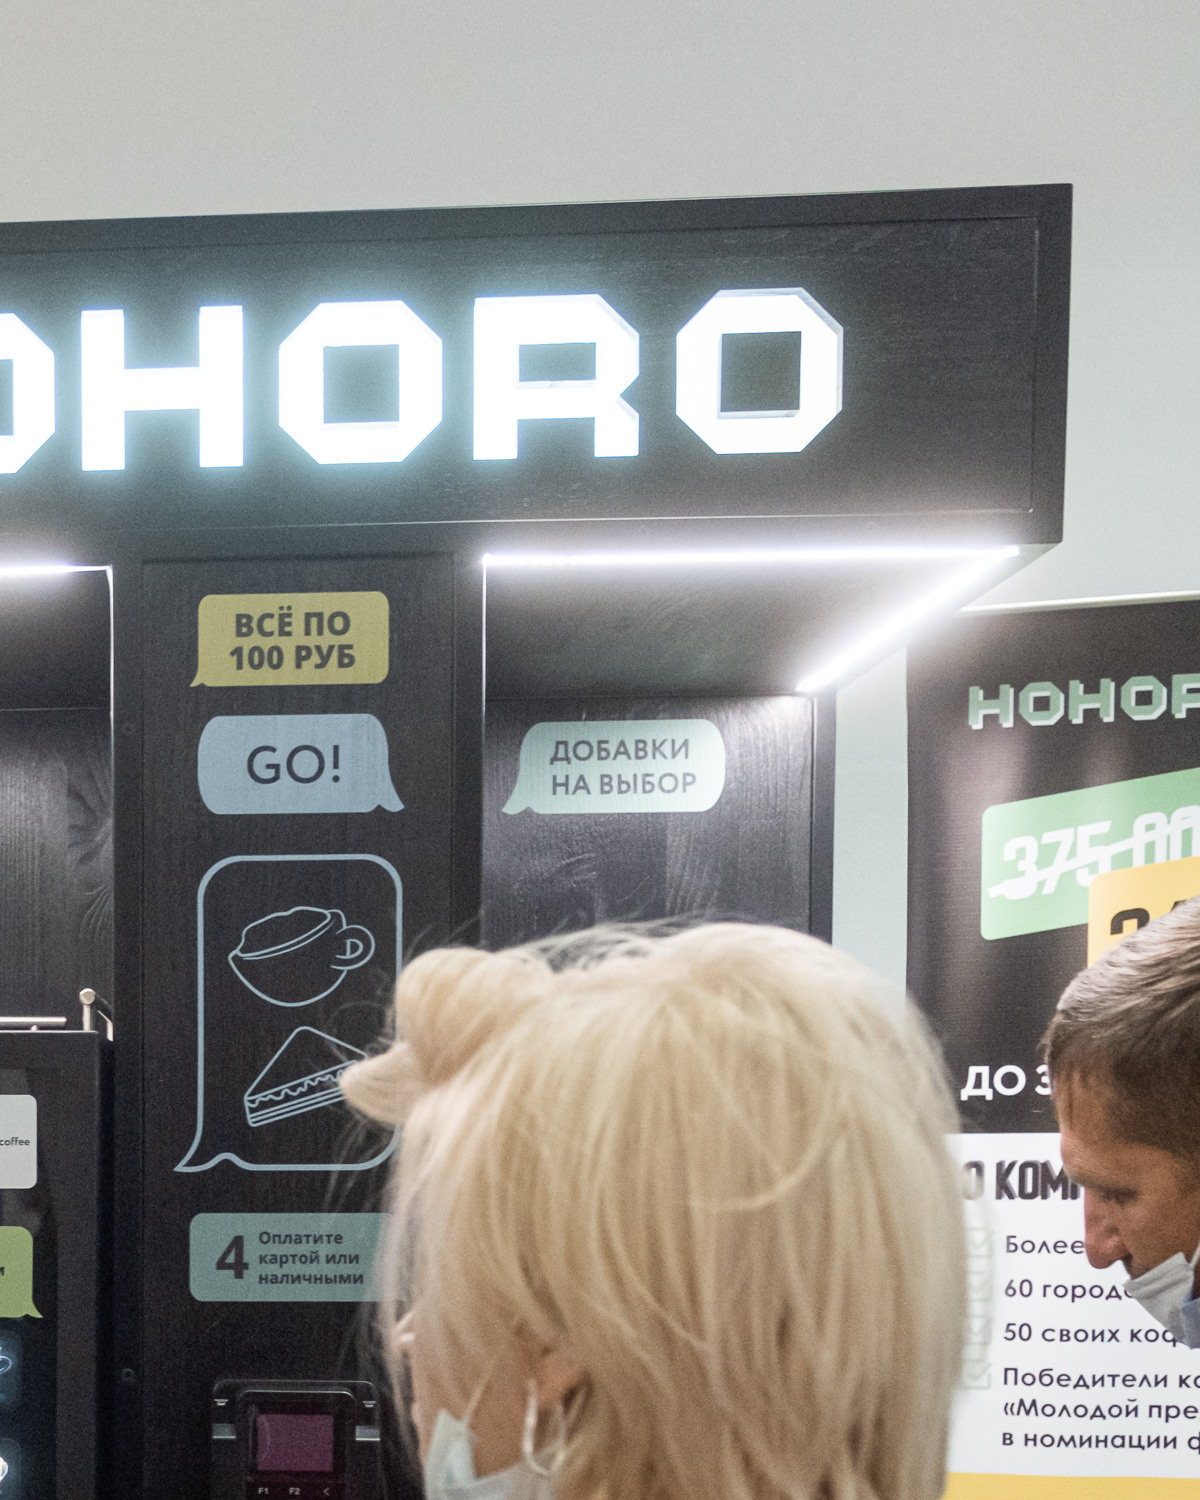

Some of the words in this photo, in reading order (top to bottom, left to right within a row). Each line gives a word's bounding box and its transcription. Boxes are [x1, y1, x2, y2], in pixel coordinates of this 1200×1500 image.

[235, 605, 293, 638] ВСЁ
[304, 611, 351, 637] ПО
[229, 645, 284, 670] 100
[295, 643, 356, 670] РУБ
[550, 739, 690, 765] ДОБАВКИ
[247, 744, 340, 784] GO!
[552, 774, 592, 796] НА
[599, 772, 697, 796] ВЫБОР
[960, 1064, 1027, 1101] ДО
[258, 1231, 344, 1245] Оплатите
[1005, 1235, 1085, 1255] Более
[215, 1234, 250, 1280] 4
[259, 1251, 321, 1268] картой
[325, 1252, 360, 1265] или
[258, 1272, 365, 1285] наличными
[1004, 1279, 1034, 1299] 60
[1003, 1323, 1033, 1342] 50
[1041, 1327, 1121, 1343] своих
[1003, 1367, 1169, 1389] Победители
[1003, 1399, 1140, 1421] «Молодой
[1002, 1432, 1014, 1447] в
[1024, 1432, 1178, 1451] номинации
[257, 1487, 269, 1495] F1
[288, 1487, 301, 1495] F2
